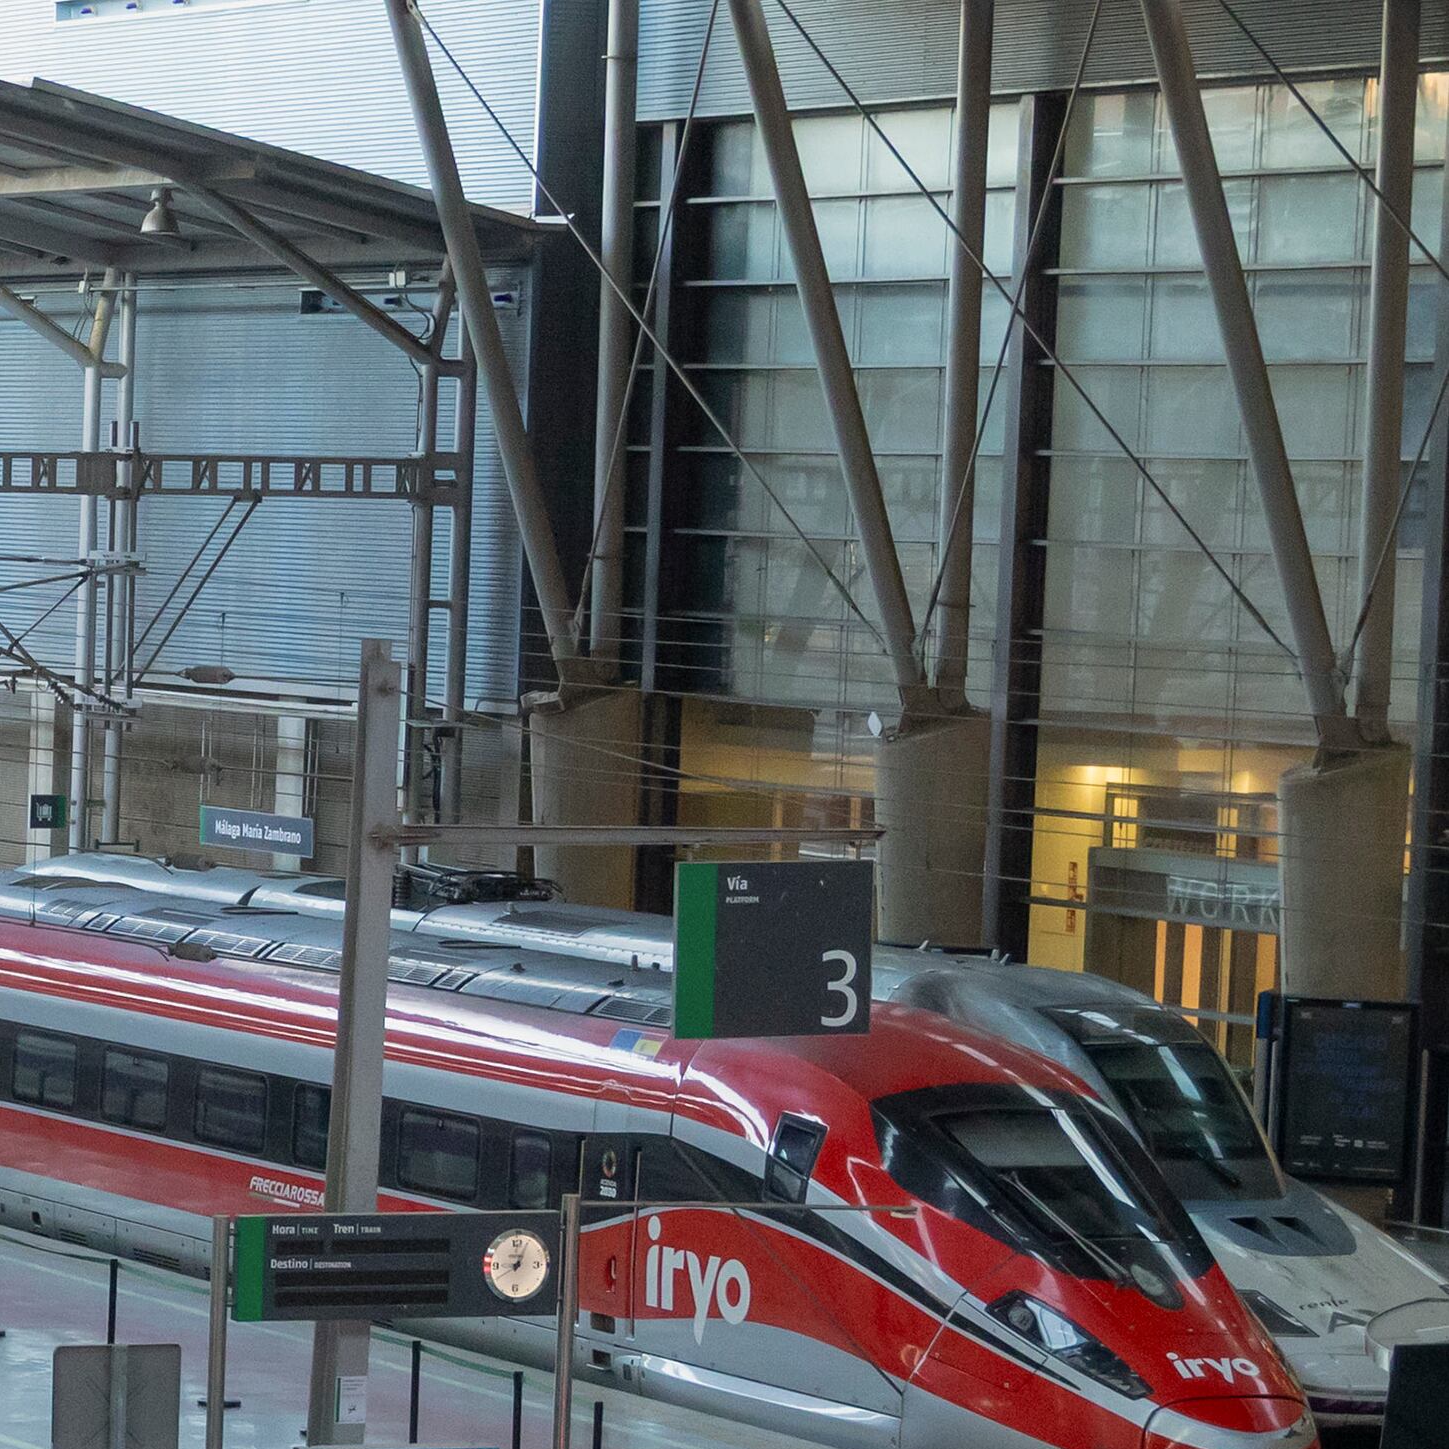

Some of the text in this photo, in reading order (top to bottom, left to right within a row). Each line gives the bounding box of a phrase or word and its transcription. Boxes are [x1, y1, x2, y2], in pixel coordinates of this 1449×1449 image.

[215, 819, 302, 844] Málaga María Zambrano
[727, 875, 748, 891] Vía
[725, 896, 759, 904] PLATFORM
[820, 949, 858, 1028] 3
[249, 1175, 325, 1207] FRECCIAROSSA
[272, 1224, 295, 1235] Hora
[334, 1223, 355, 1234] Tren
[512, 1239, 523, 1248] 12
[270, 1258, 351, 1269] Destino DESTINATION
[492, 1261, 499, 1270] 9
[533, 1261, 540, 1269] 3
[646, 1215, 751, 1346] iryo
[511, 1284, 518, 1293] 6
[1299, 1294, 1349, 1311] renfe
[1166, 1352, 1261, 1384] iryo
